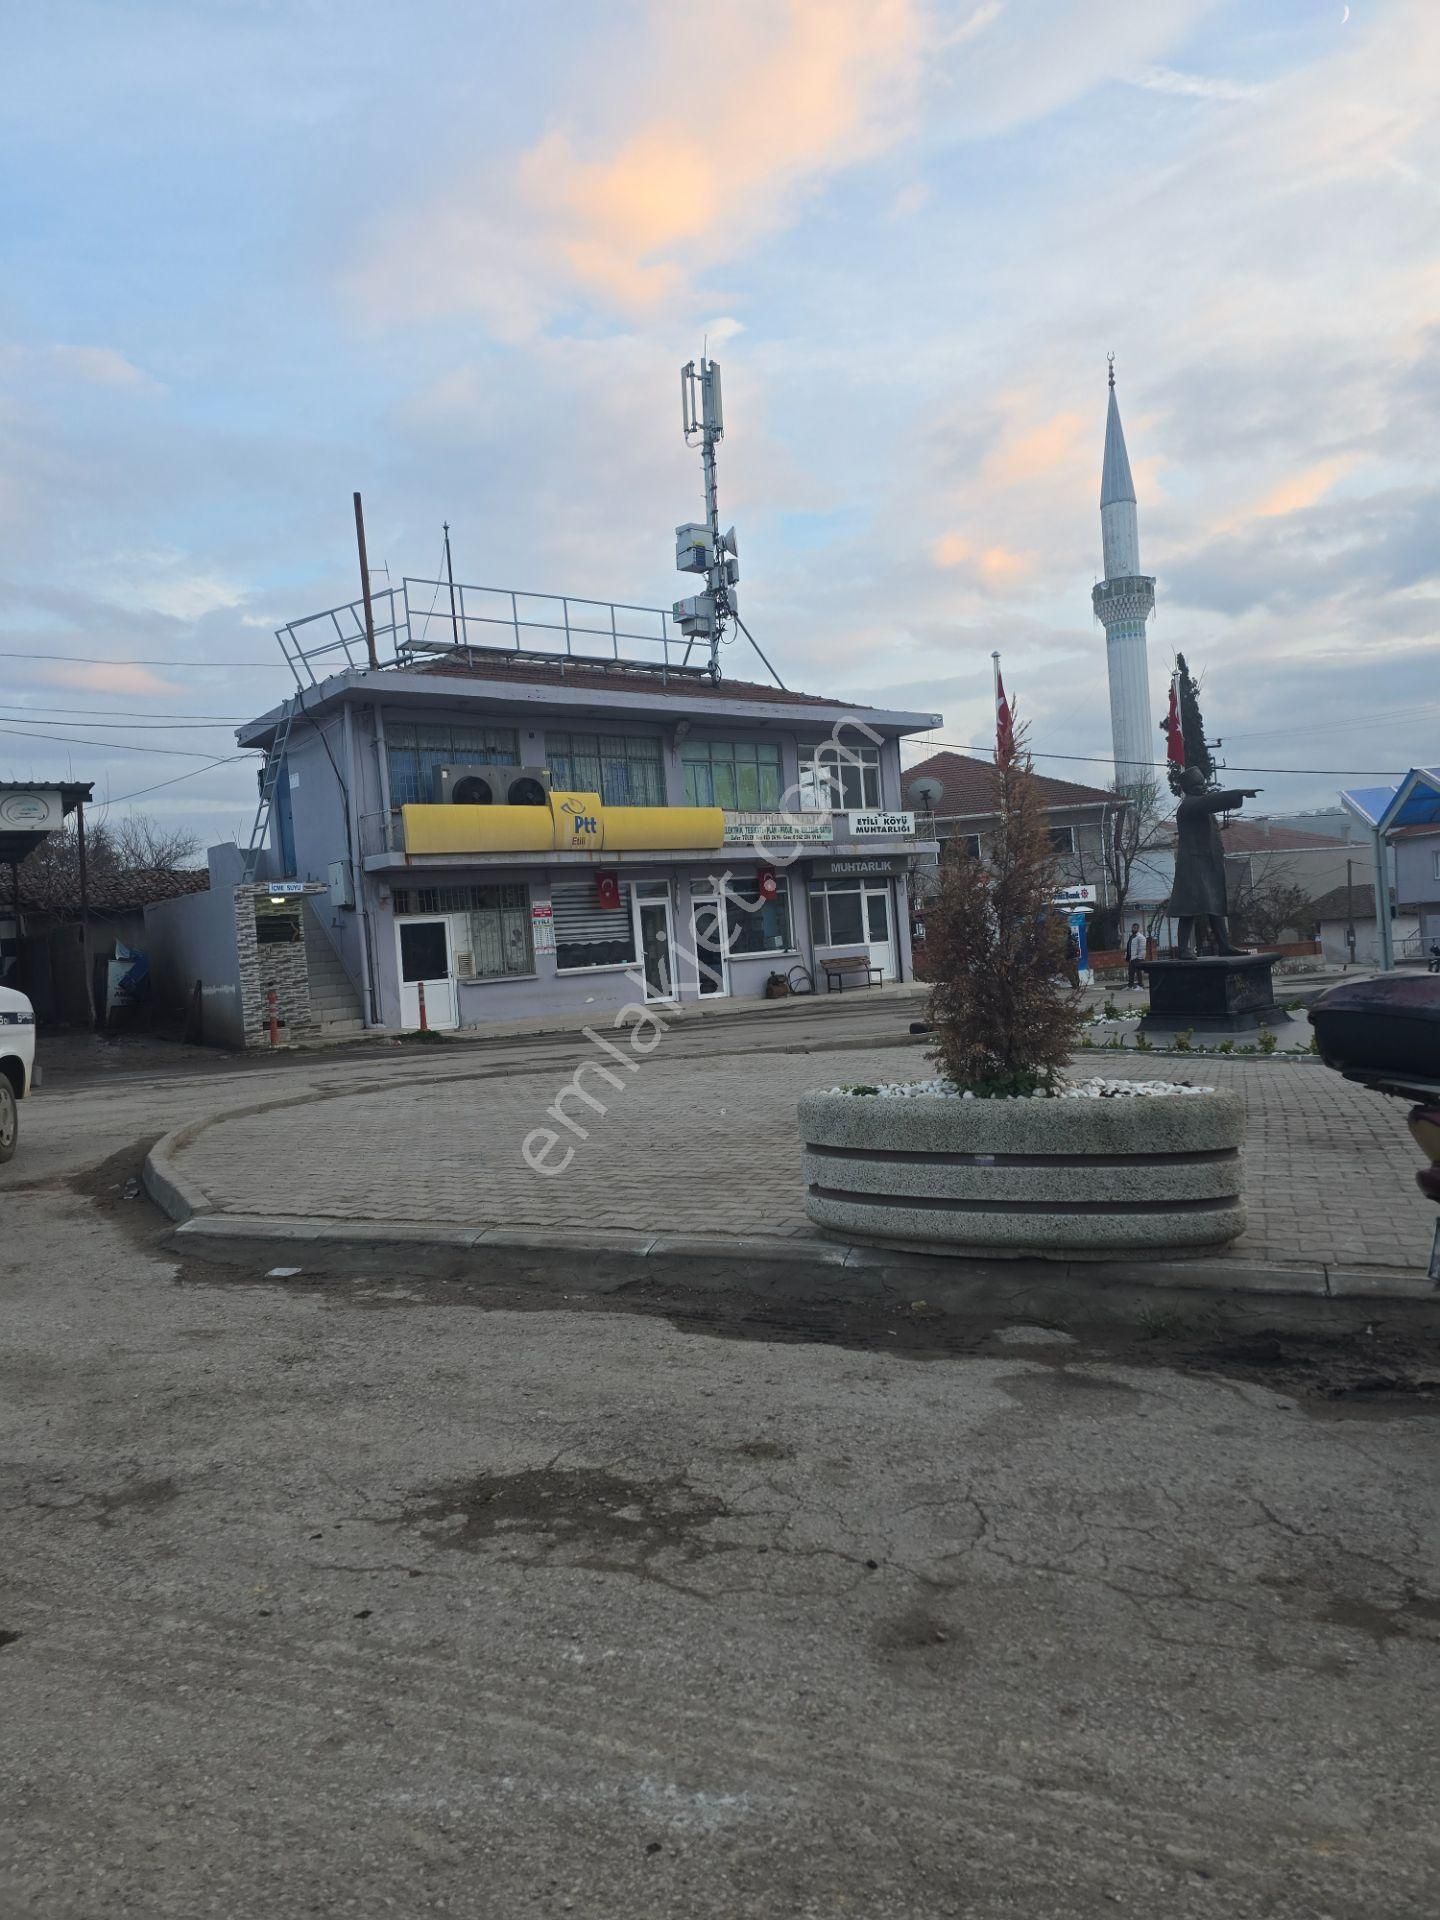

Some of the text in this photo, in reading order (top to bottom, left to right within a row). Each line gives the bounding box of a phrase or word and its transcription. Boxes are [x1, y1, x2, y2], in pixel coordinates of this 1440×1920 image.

[574, 815, 597, 834] Ptt
[857, 816, 907, 825] ETİLİ KÖYÜ
[856, 825, 910, 833] MUHTARLIĞI
[831, 861, 892, 872] MUHTARLIK
